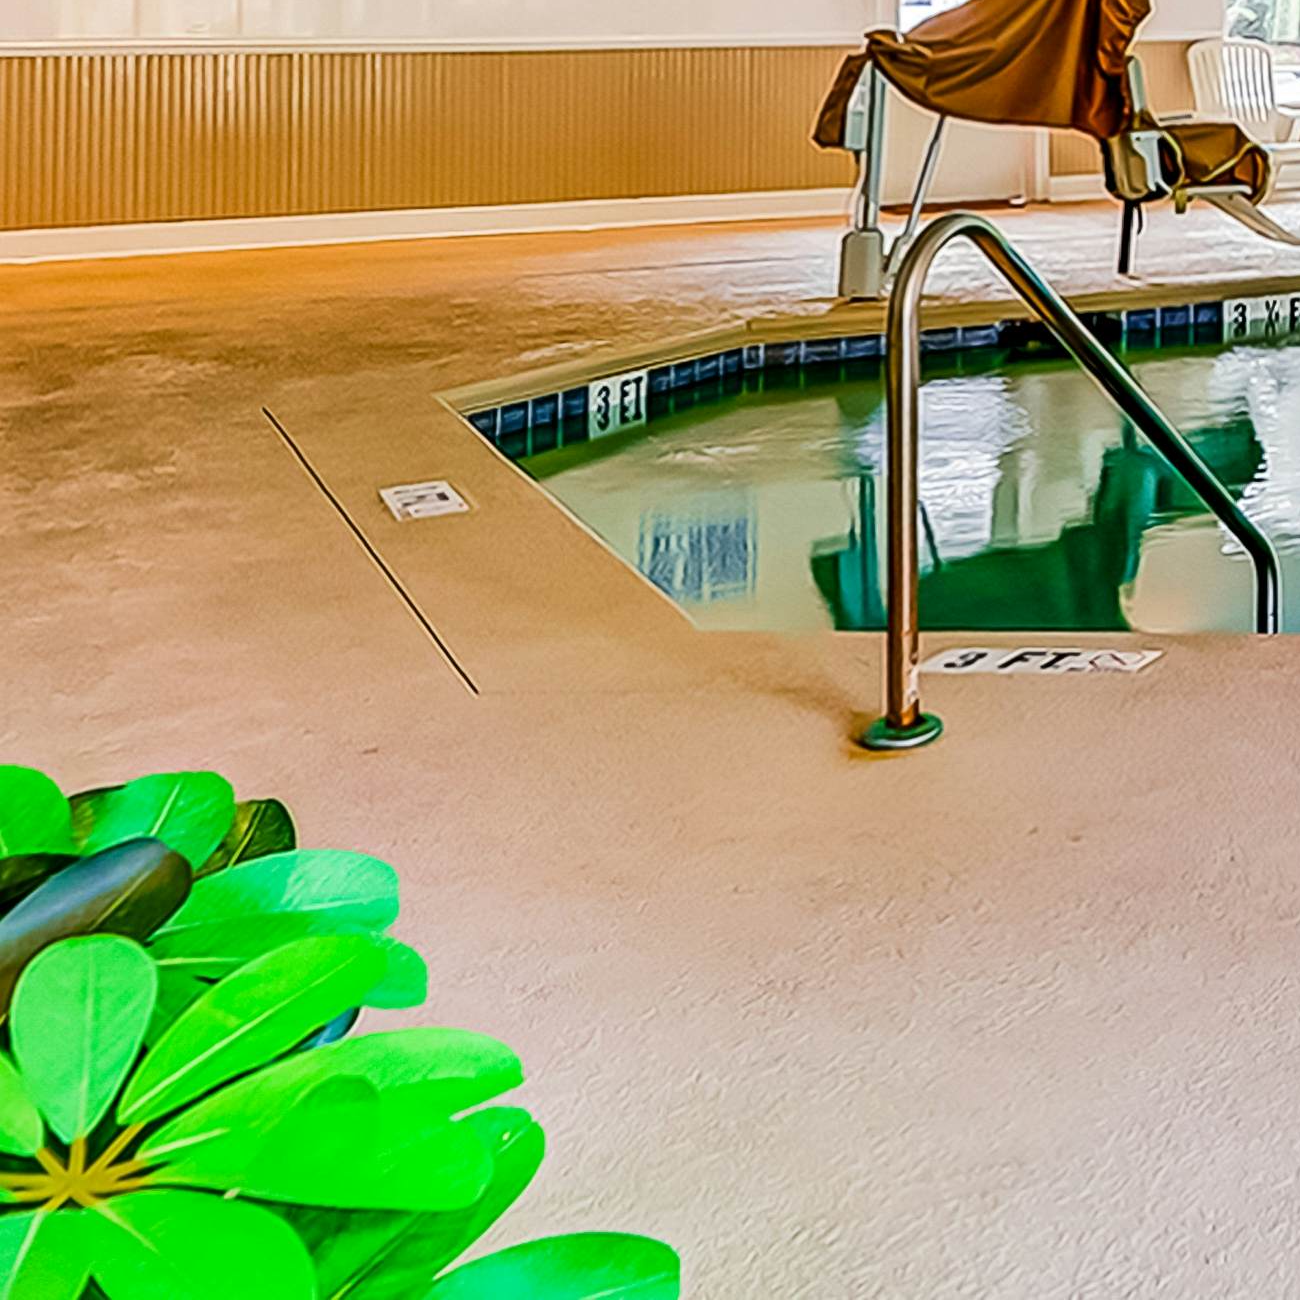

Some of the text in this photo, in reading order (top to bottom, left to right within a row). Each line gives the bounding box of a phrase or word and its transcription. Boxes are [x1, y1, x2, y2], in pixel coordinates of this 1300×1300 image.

[597, 376, 643, 431] 3 FT
[944, 652, 988, 668] 3
